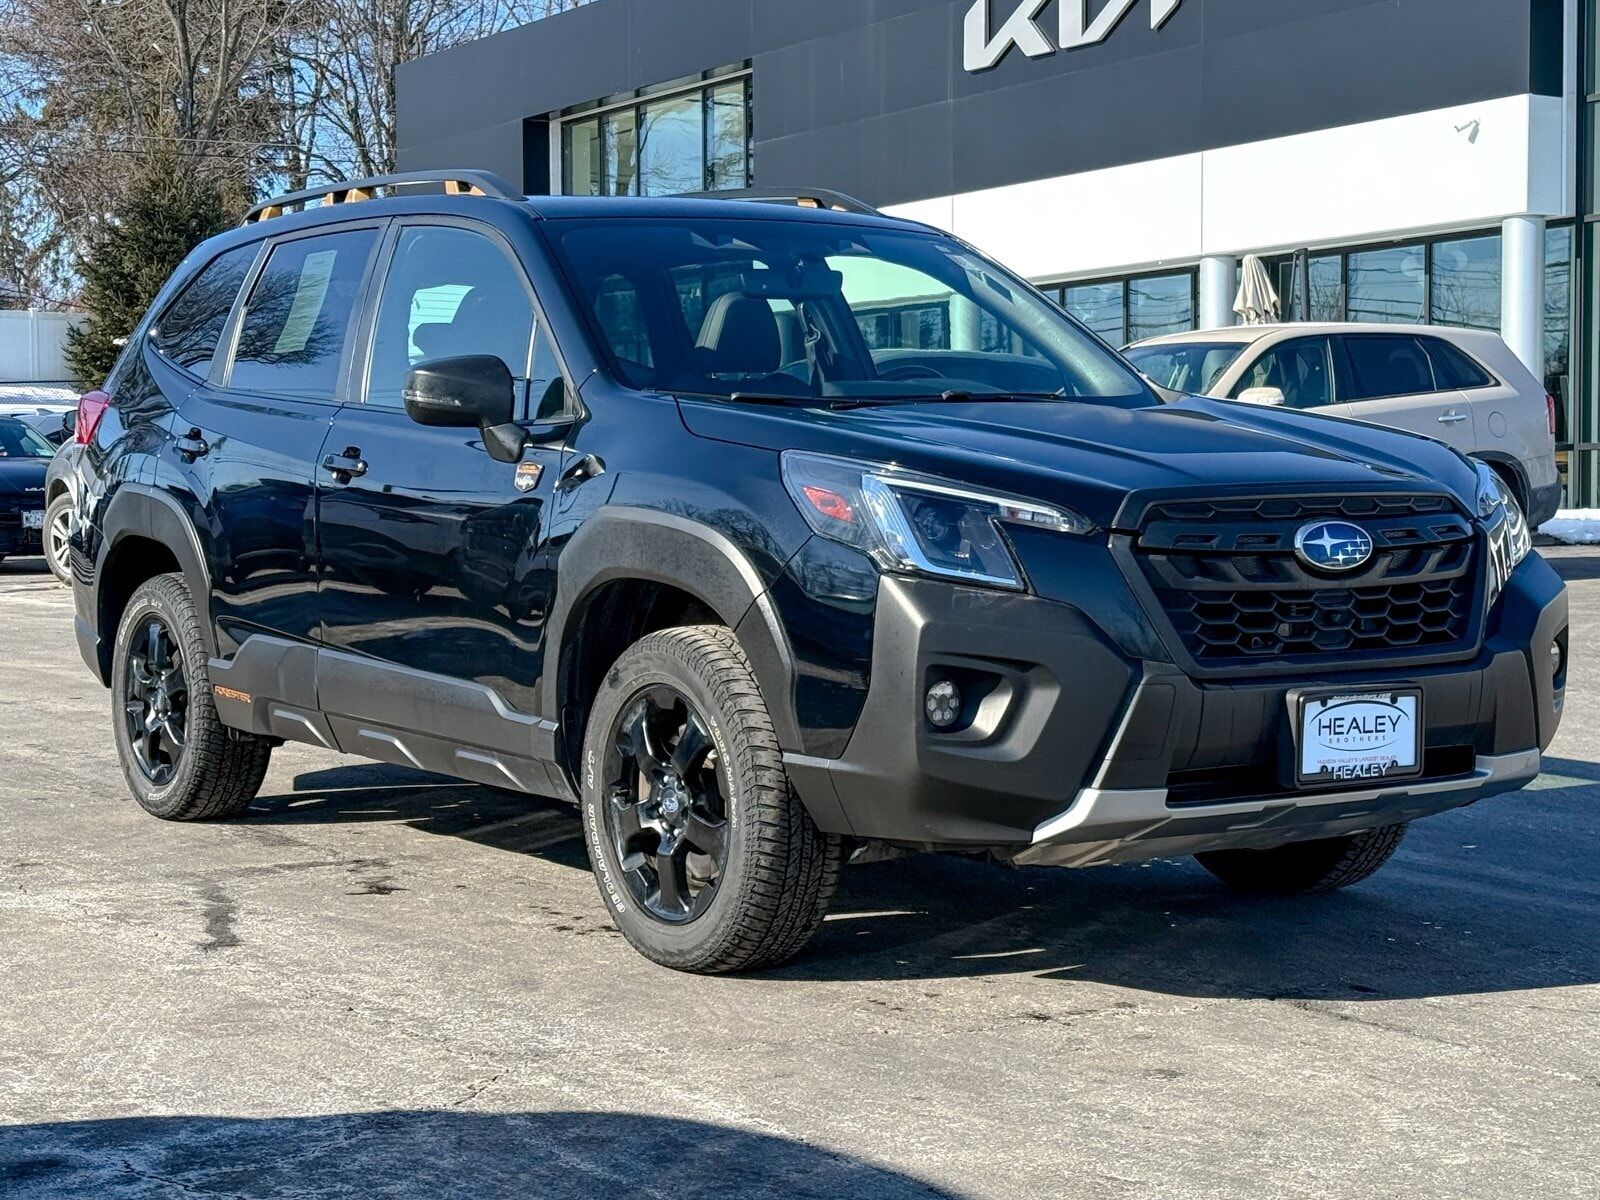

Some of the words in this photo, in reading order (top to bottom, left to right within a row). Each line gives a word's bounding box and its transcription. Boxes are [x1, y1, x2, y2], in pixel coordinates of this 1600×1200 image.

[214, 685, 252, 704] FORESTER
[1318, 714, 1402, 736] HEALEY
[1328, 735, 1386, 744] BROTHERS
[1333, 763, 1388, 780] HEALEY
[587, 803, 626, 913] GEOLANDAR
